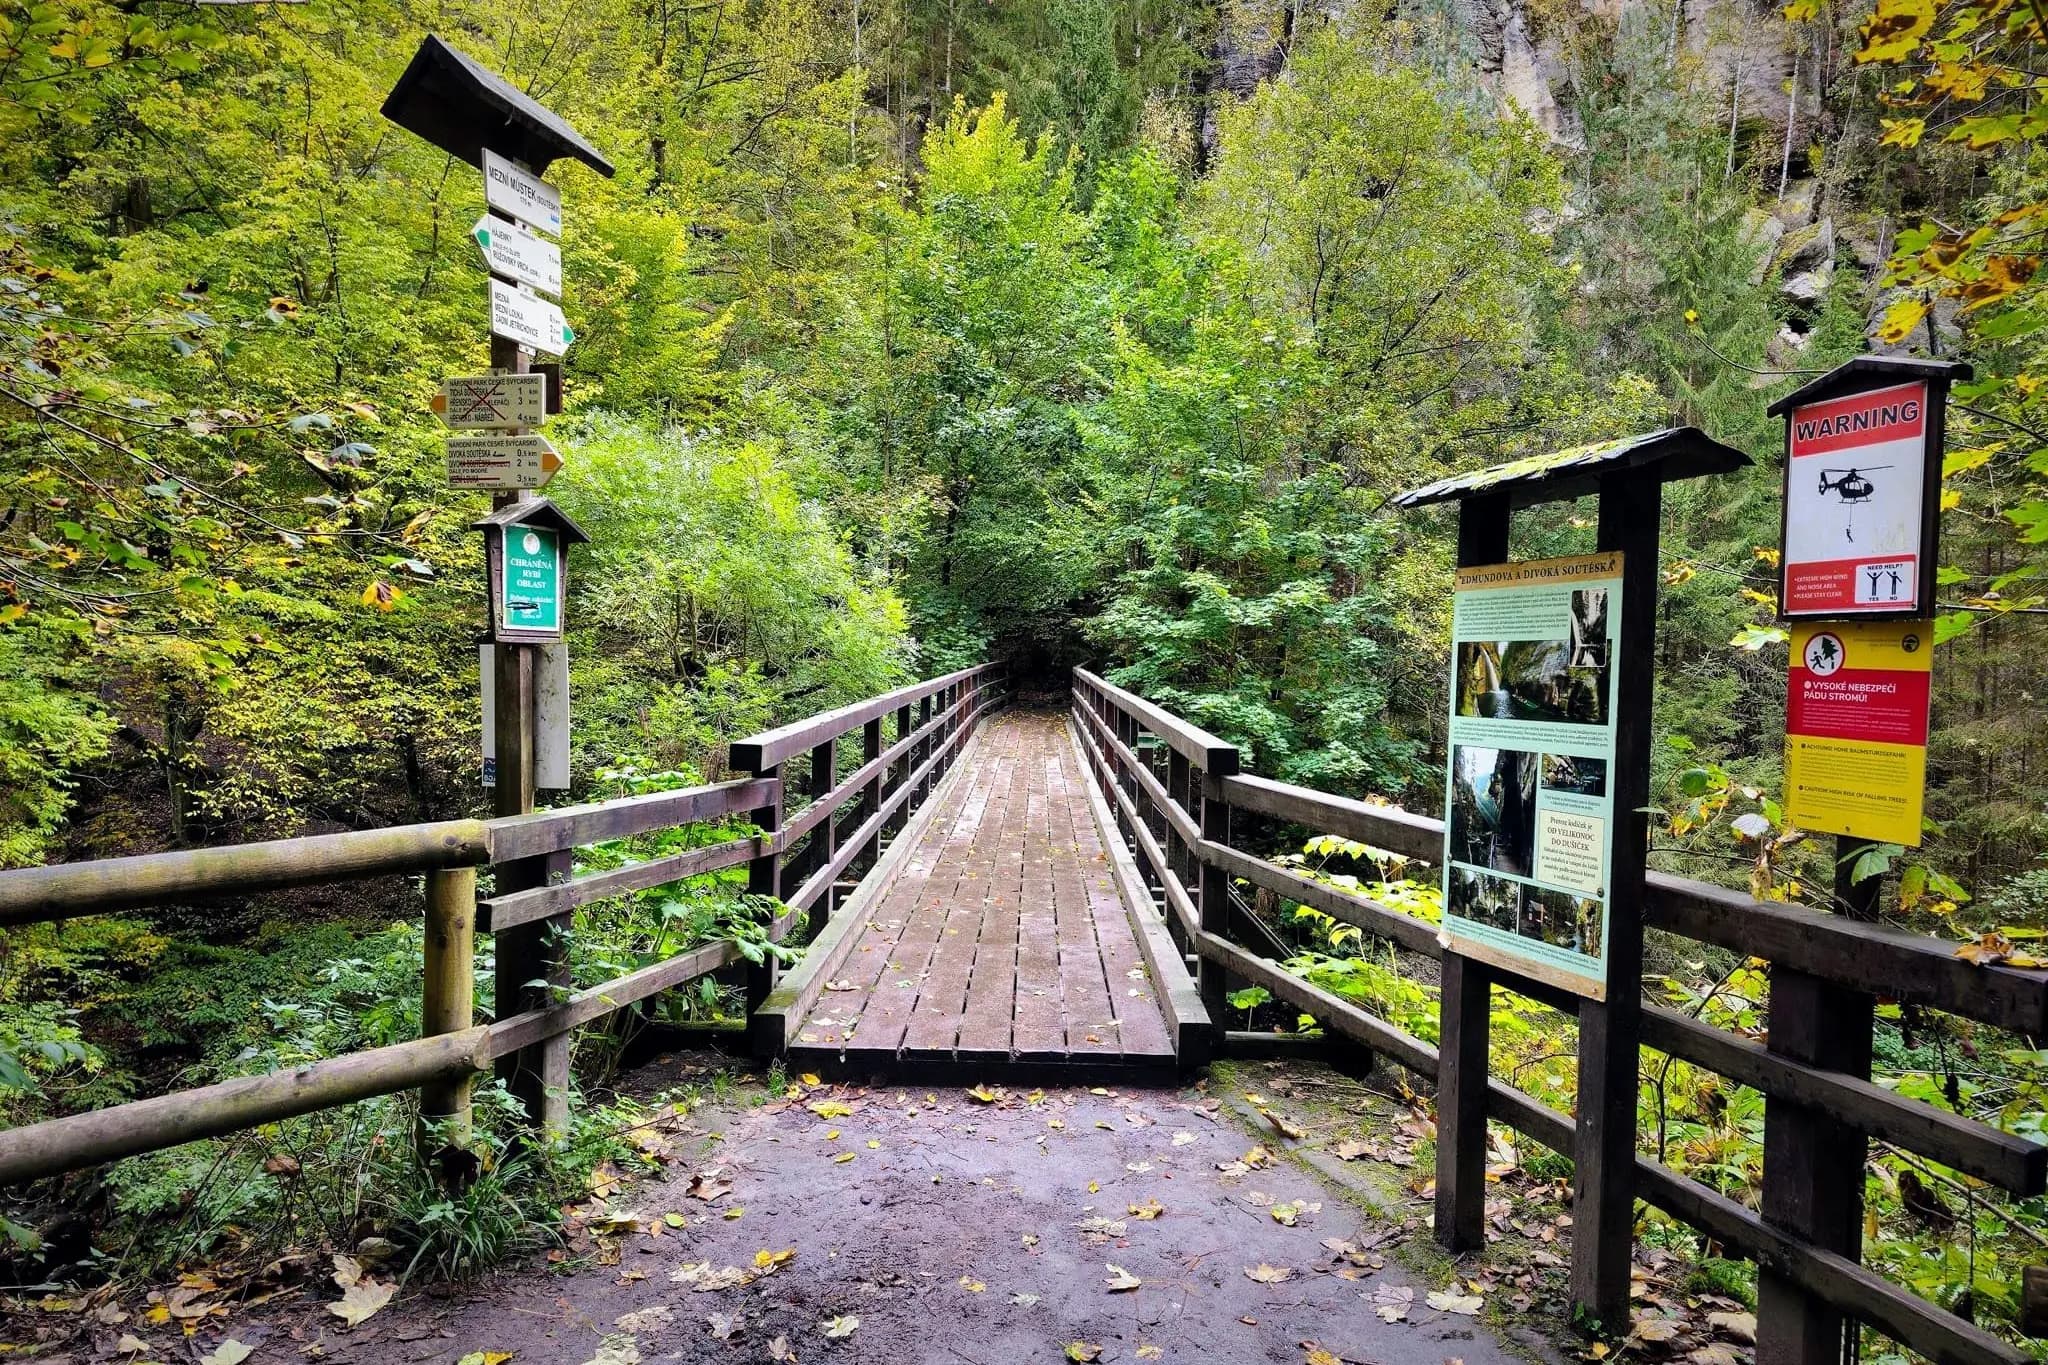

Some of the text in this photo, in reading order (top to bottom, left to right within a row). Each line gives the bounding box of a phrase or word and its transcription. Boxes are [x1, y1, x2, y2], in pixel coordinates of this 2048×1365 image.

[488, 165, 509, 187] MEZNÍ
[1796, 401, 1918, 442] WARNING
[510, 558, 552, 570] CHRÁNĚNÁ
[1524, 567, 1560, 579] DIVOKÁ
[516, 580, 546, 588] OBLAST
[1812, 681, 1896, 693] VYSOKÉ NEBEZPEČÍ
[1804, 690, 1868, 702] PÁDU STROMŮ!
